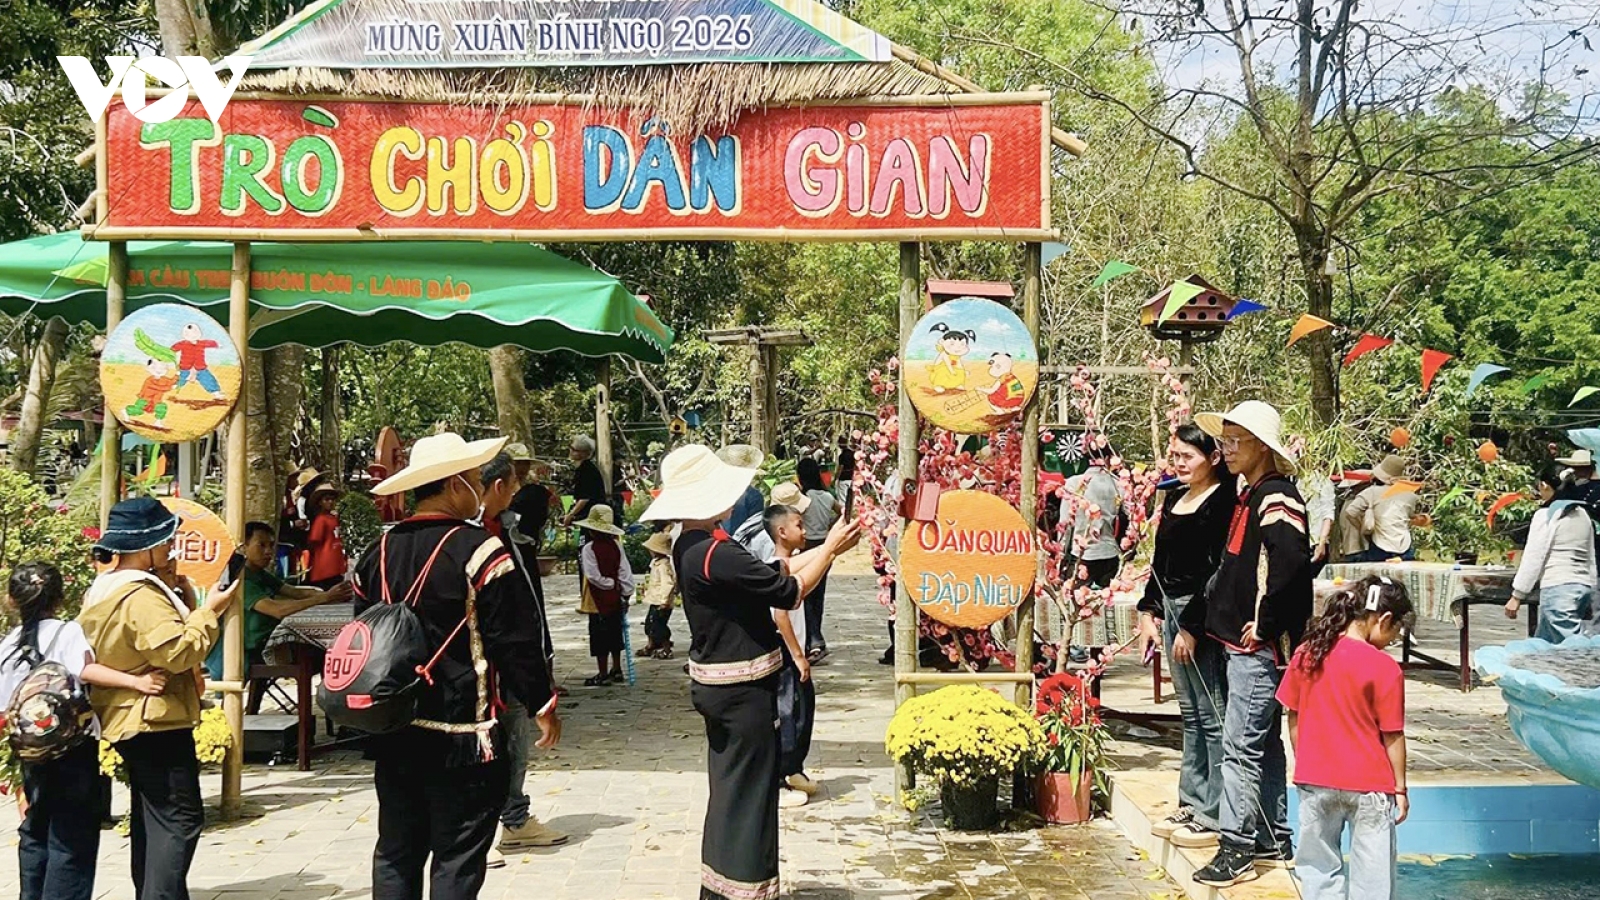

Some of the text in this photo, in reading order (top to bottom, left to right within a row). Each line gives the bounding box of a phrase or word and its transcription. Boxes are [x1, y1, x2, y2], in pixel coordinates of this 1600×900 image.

[367, 14, 752, 56] MỪNG XUÂN BÍNH NGỌ 2026
[139, 104, 345, 216] TRÒ
[582, 117, 742, 217] DÂN
[917, 570, 1023, 616] ĐẬP NIÊU
